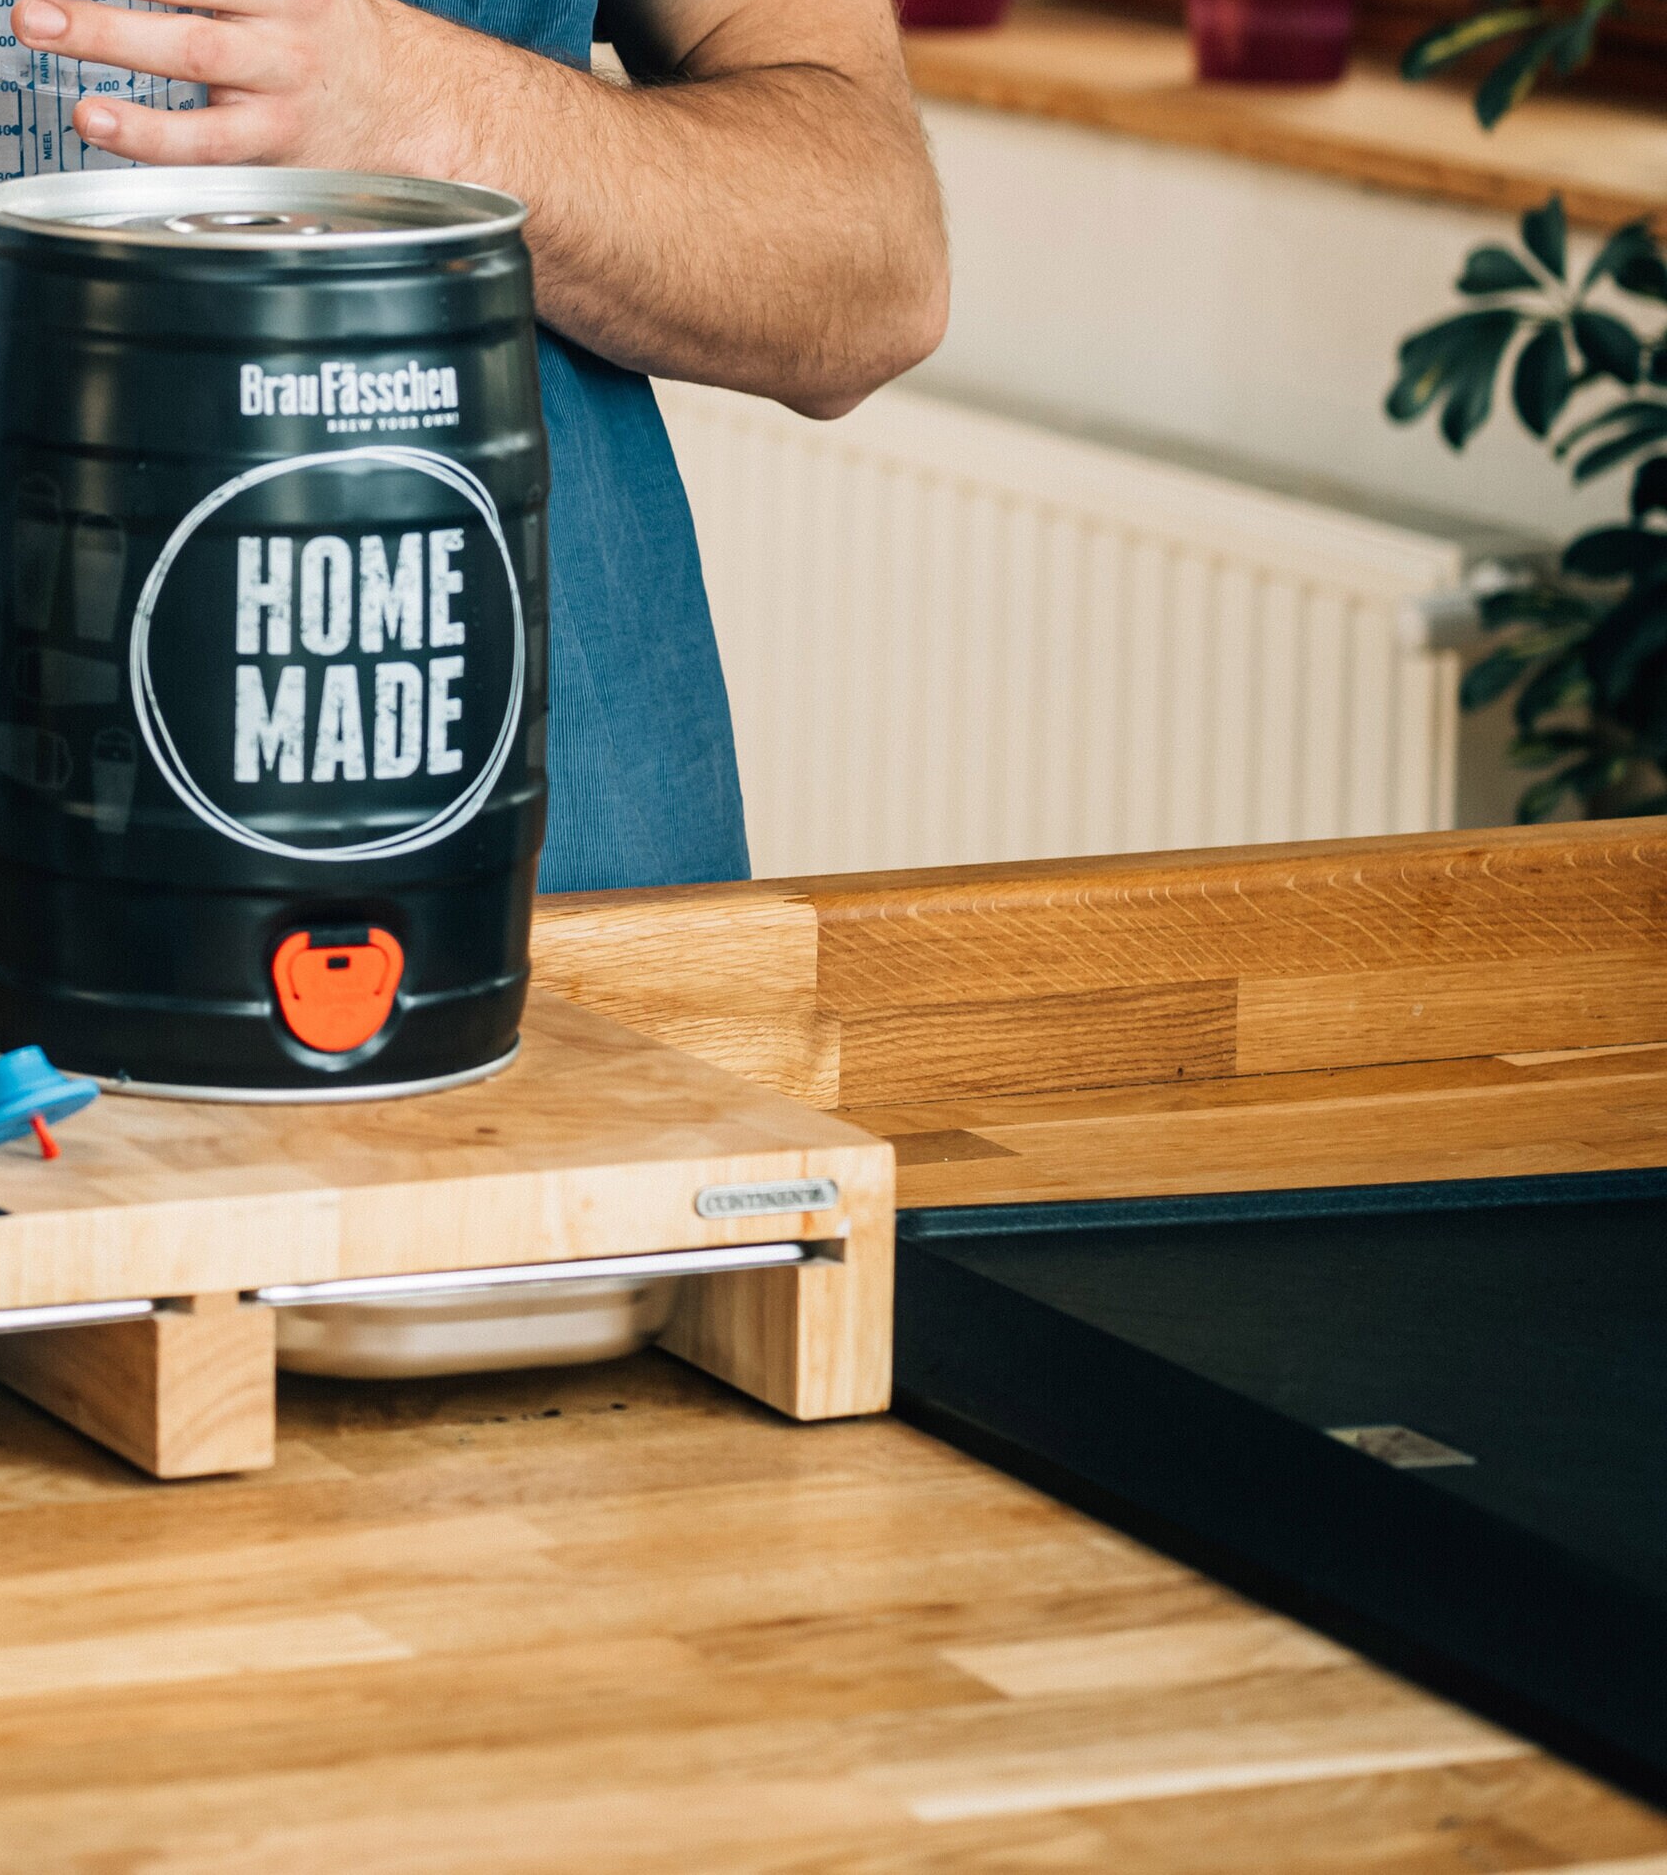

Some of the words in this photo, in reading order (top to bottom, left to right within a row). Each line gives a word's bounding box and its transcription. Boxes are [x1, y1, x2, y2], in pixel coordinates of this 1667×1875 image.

[40, 53, 49, 84] FARIN
[95, 80, 120, 93] 400
[44, 130, 52, 160] MEEL
[240, 360, 458, 416] BrauFässchen
[235, 528, 465, 655] HOME
[234, 656, 464, 783] MADE
